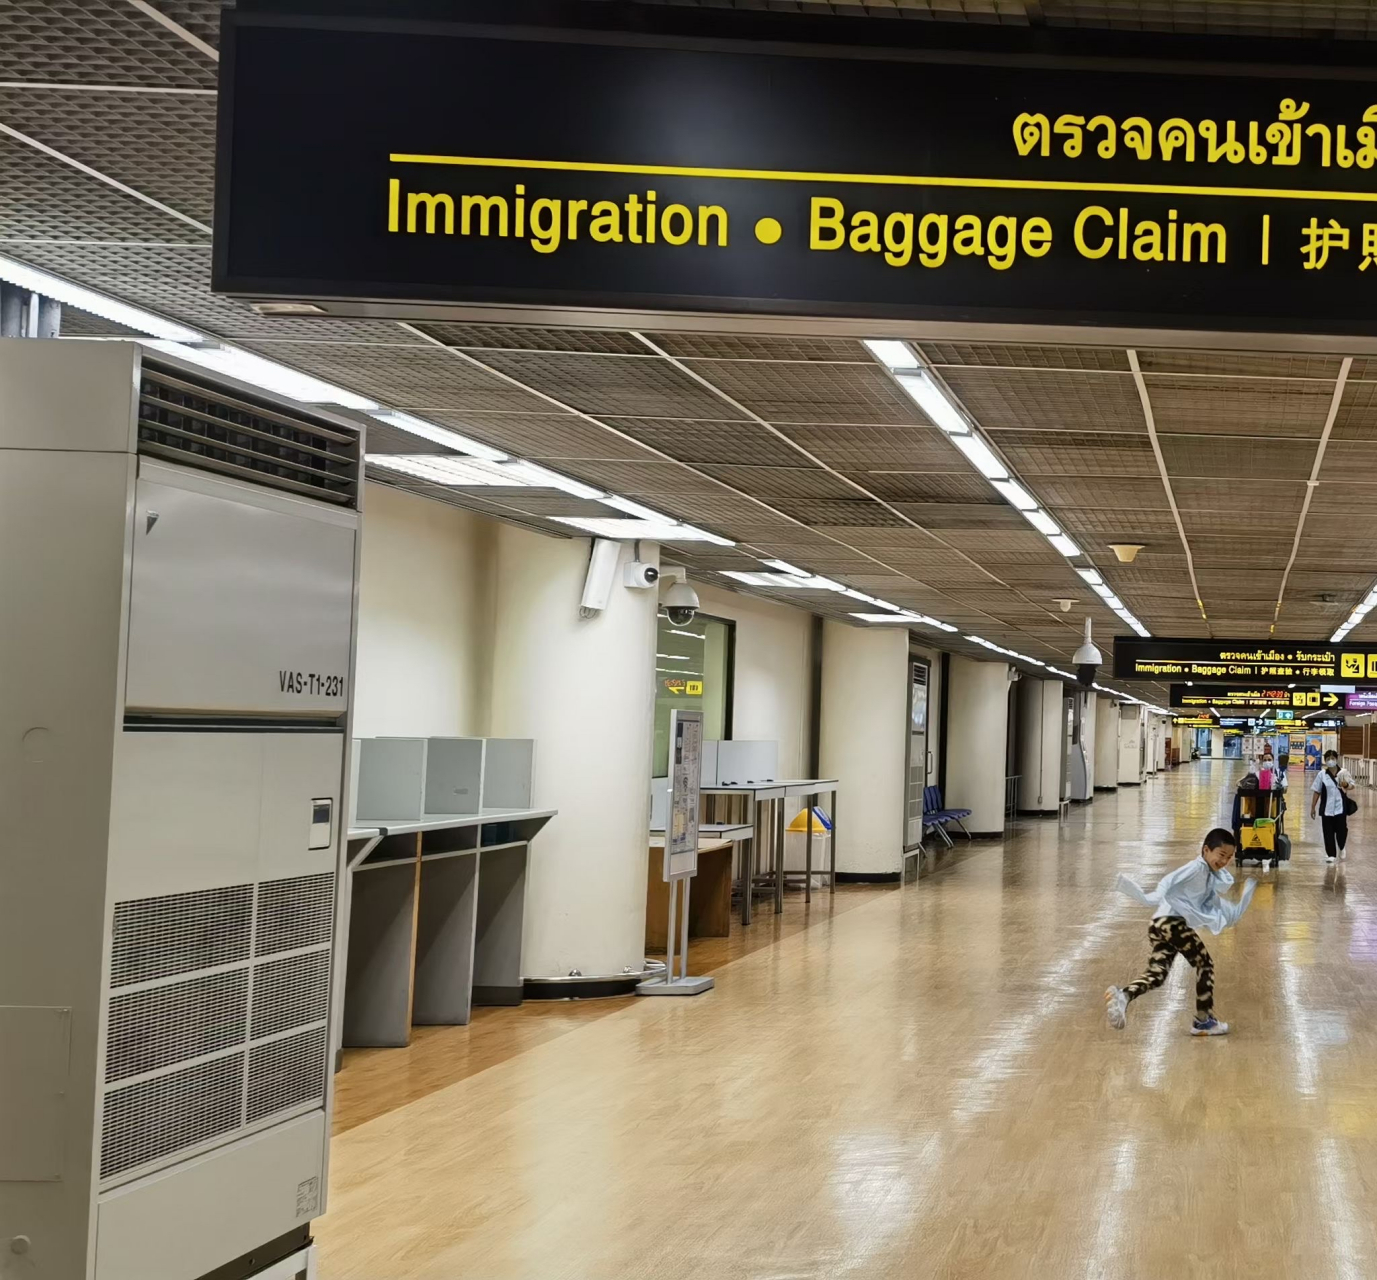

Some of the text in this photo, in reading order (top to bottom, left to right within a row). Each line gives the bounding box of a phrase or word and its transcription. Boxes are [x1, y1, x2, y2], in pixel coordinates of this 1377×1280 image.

[388, 178, 1227, 271] Immigration Baggage Claim
[1135, 663, 1251, 675] Immigration Baggage Claim
[279, 670, 344, 697] VAS-T1-231
